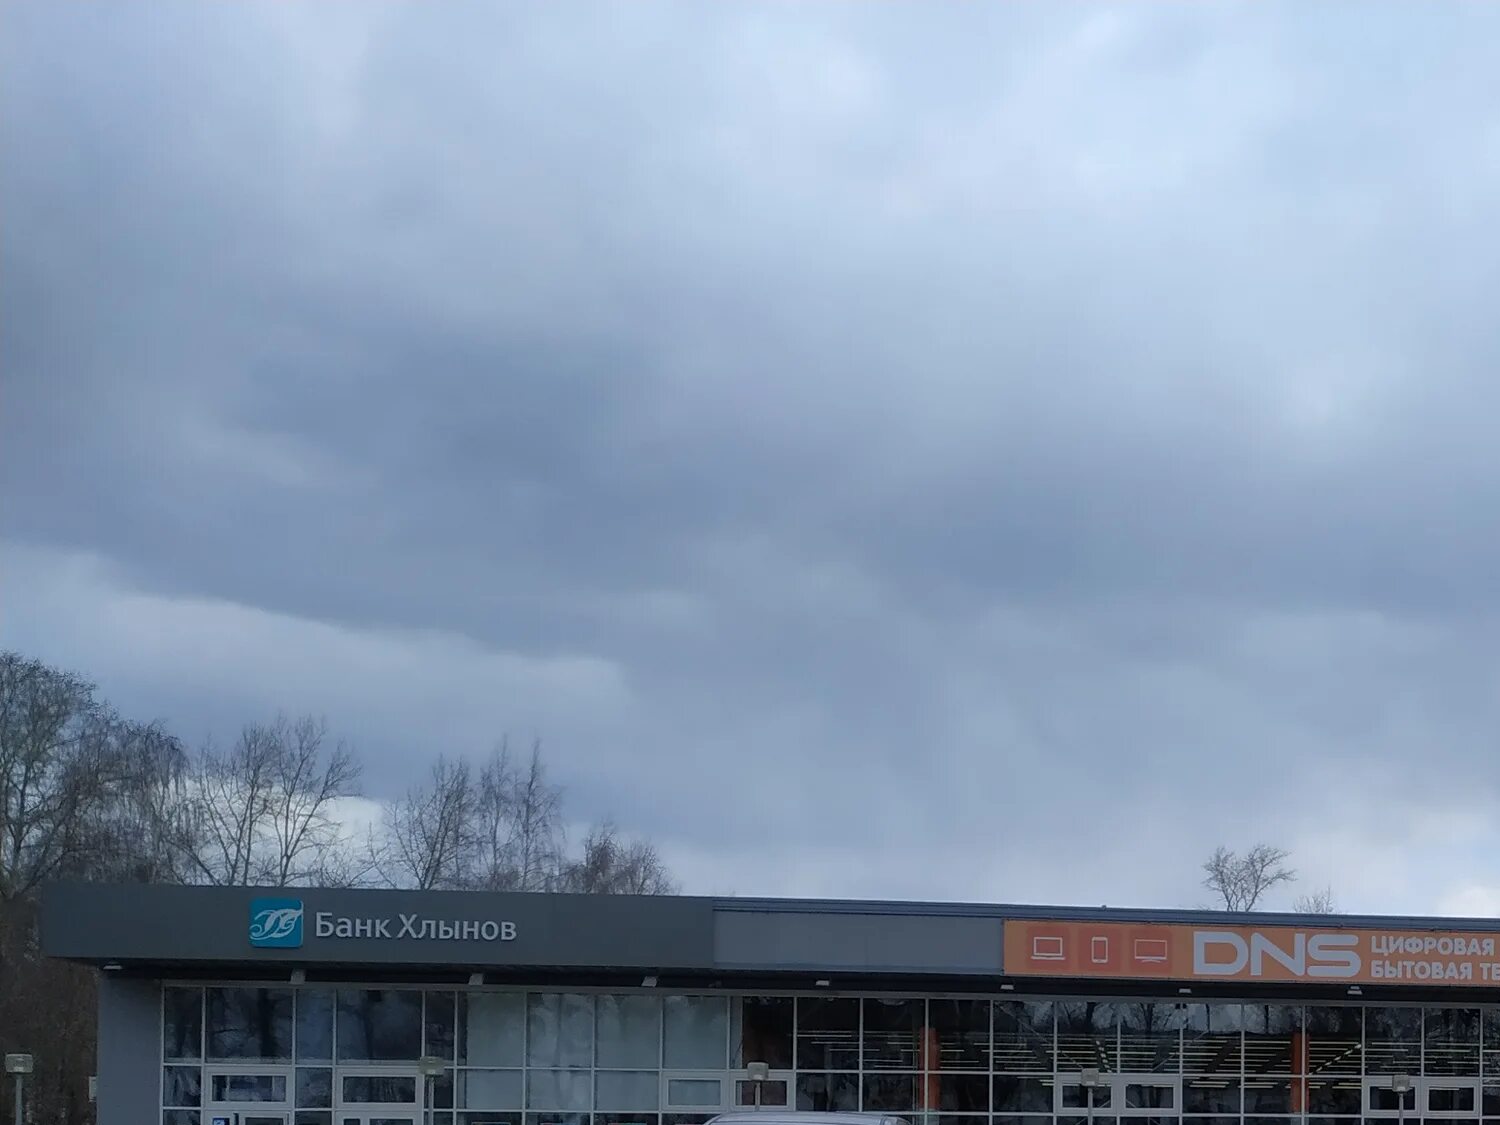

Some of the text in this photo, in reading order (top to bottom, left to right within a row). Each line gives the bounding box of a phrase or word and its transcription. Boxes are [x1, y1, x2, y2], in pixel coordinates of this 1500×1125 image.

[315, 912, 518, 941] Банк Хлынов
[1193, 931, 1361, 977] DNS
[1371, 935, 1495, 957] ЦИФРОВАЯ
[1371, 960, 1472, 980] БЫТОВАЯ
